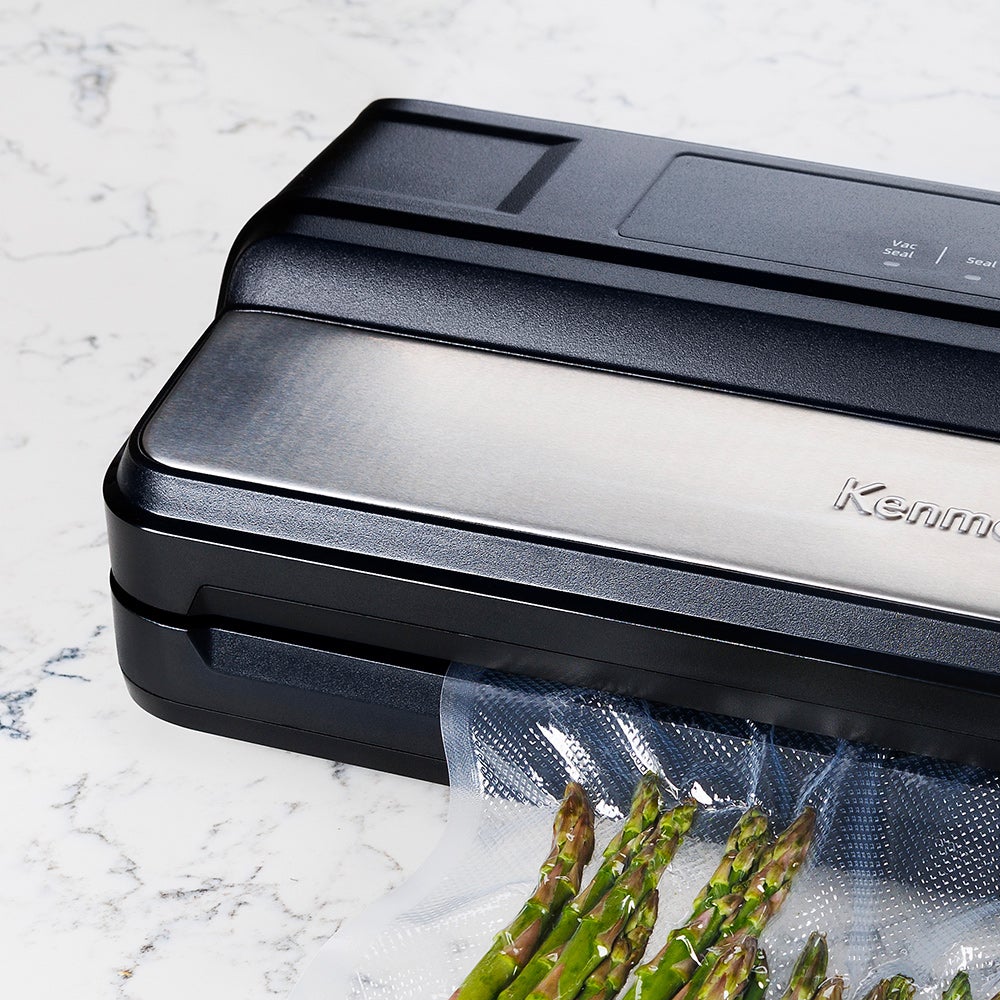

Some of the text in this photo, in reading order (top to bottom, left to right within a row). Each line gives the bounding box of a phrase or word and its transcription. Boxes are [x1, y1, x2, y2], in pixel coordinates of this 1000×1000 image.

[893, 239, 918, 250] Vac
[882, 247, 915, 259] Seal
[966, 256, 998, 268] Seal
